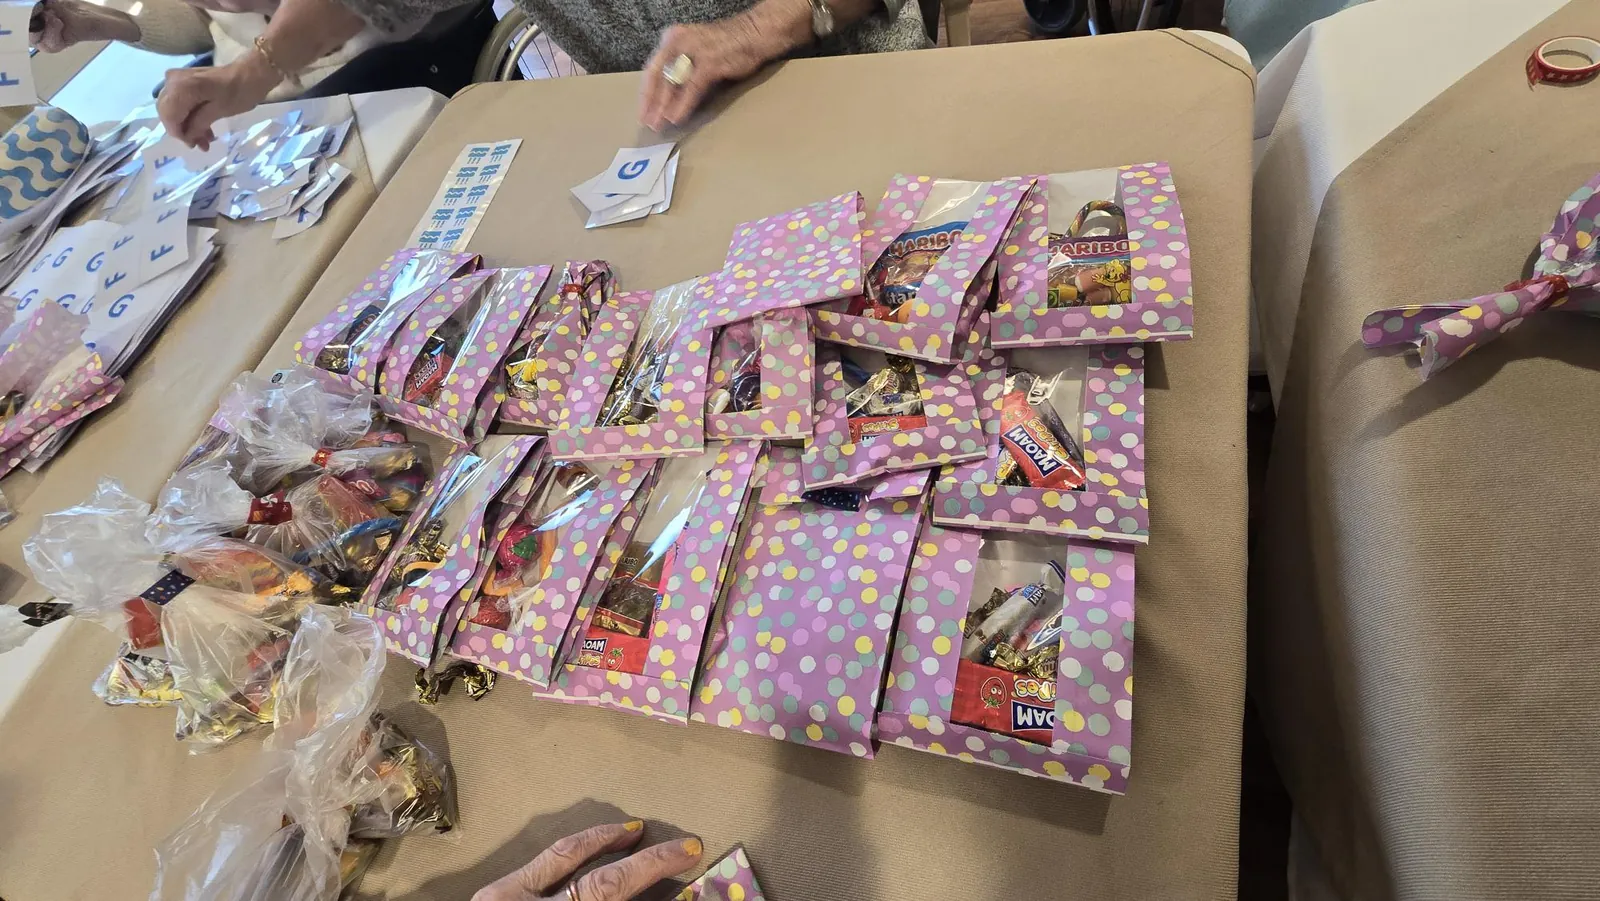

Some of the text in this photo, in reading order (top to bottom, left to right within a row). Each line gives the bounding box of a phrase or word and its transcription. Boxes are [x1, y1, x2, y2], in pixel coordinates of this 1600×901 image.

[617, 158, 651, 180] G
[112, 235, 134, 251] F
[150, 245, 174, 261] F
[32, 247, 105, 273] G G G
[104, 272, 127, 289] F
[16, 288, 39, 311] G
[108, 293, 135, 318] G
[1008, 427, 1057, 472] MAOAM
